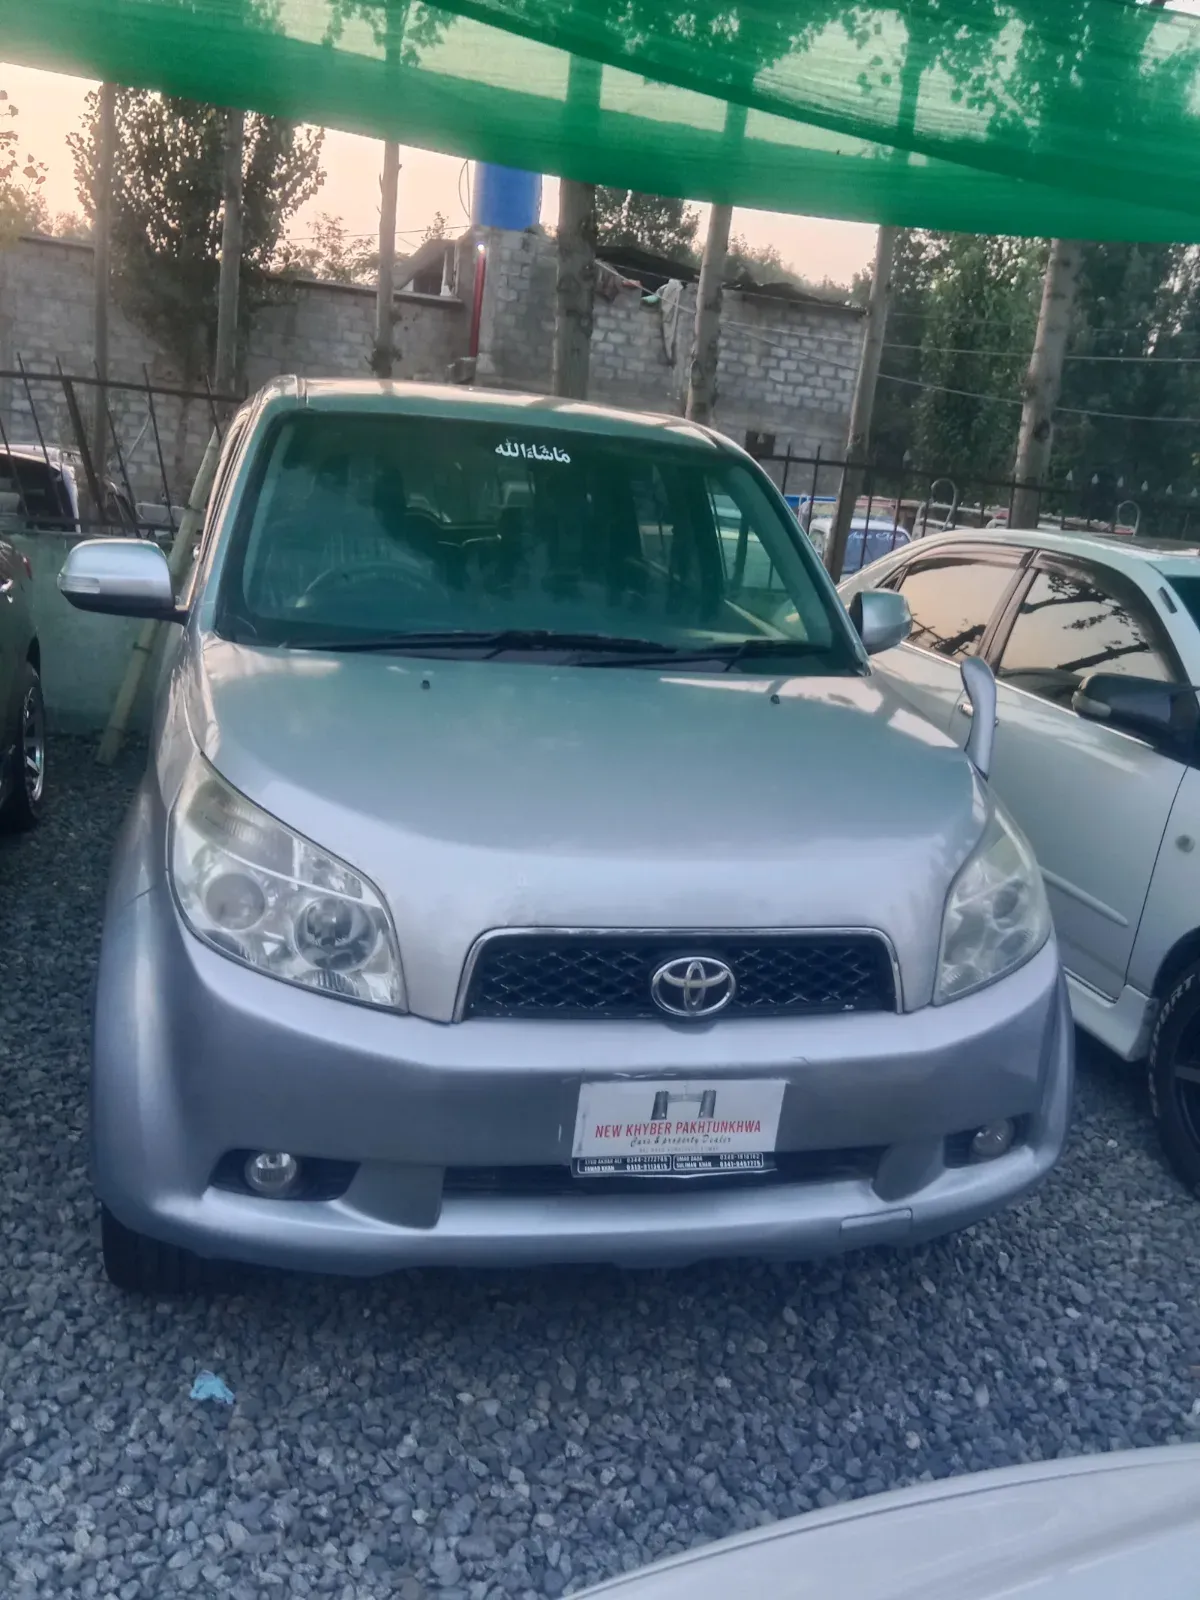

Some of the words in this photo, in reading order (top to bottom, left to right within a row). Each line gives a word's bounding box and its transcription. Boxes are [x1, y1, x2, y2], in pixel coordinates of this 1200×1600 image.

[595, 1124, 622, 1138] NEW
[626, 1122, 672, 1137] KHYBER
[675, 1119, 761, 1135] PAKHTUNKHWA
